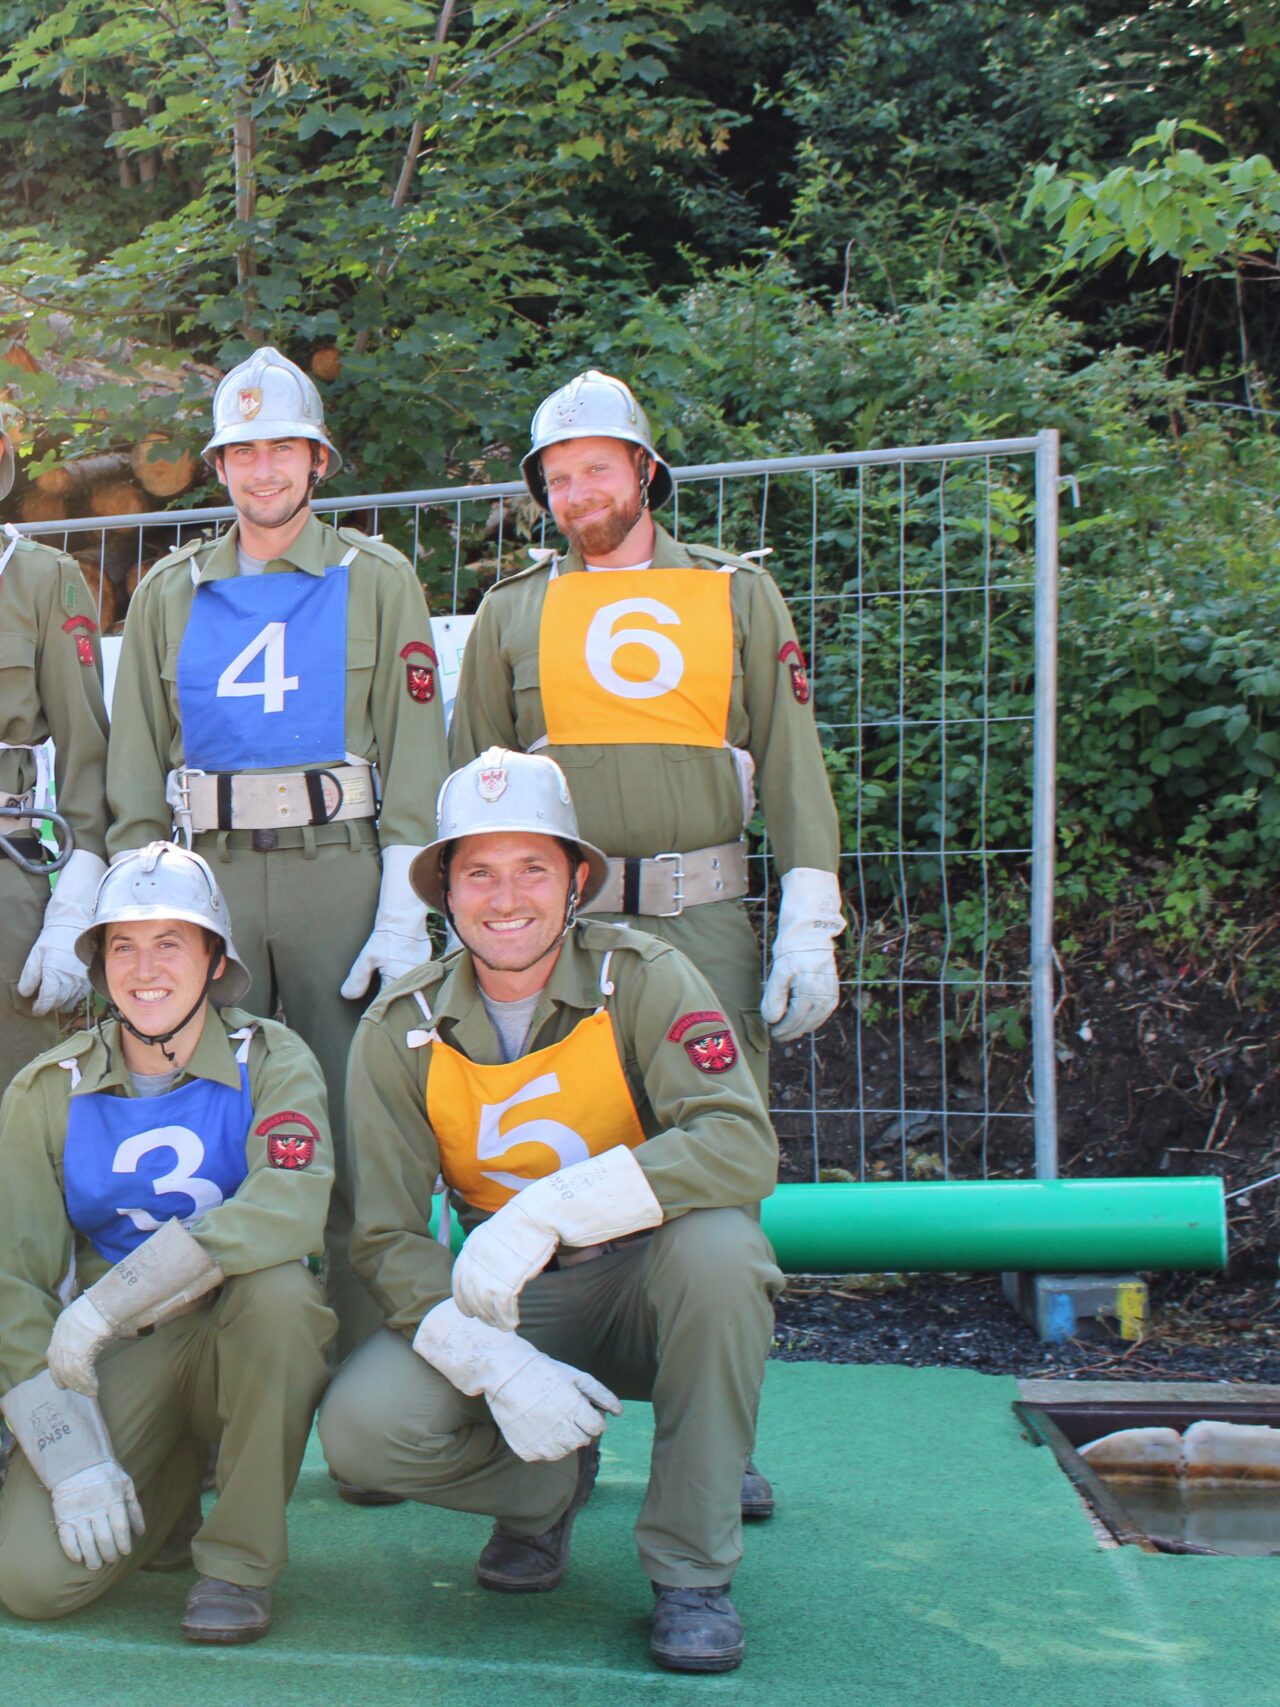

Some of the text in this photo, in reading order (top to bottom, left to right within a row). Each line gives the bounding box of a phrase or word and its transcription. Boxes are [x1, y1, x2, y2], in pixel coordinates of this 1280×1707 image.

[216, 621, 299, 713] 4
[585, 597, 683, 699] 6
[112, 1125, 223, 1231] 3
[477, 1072, 590, 1192] 5
